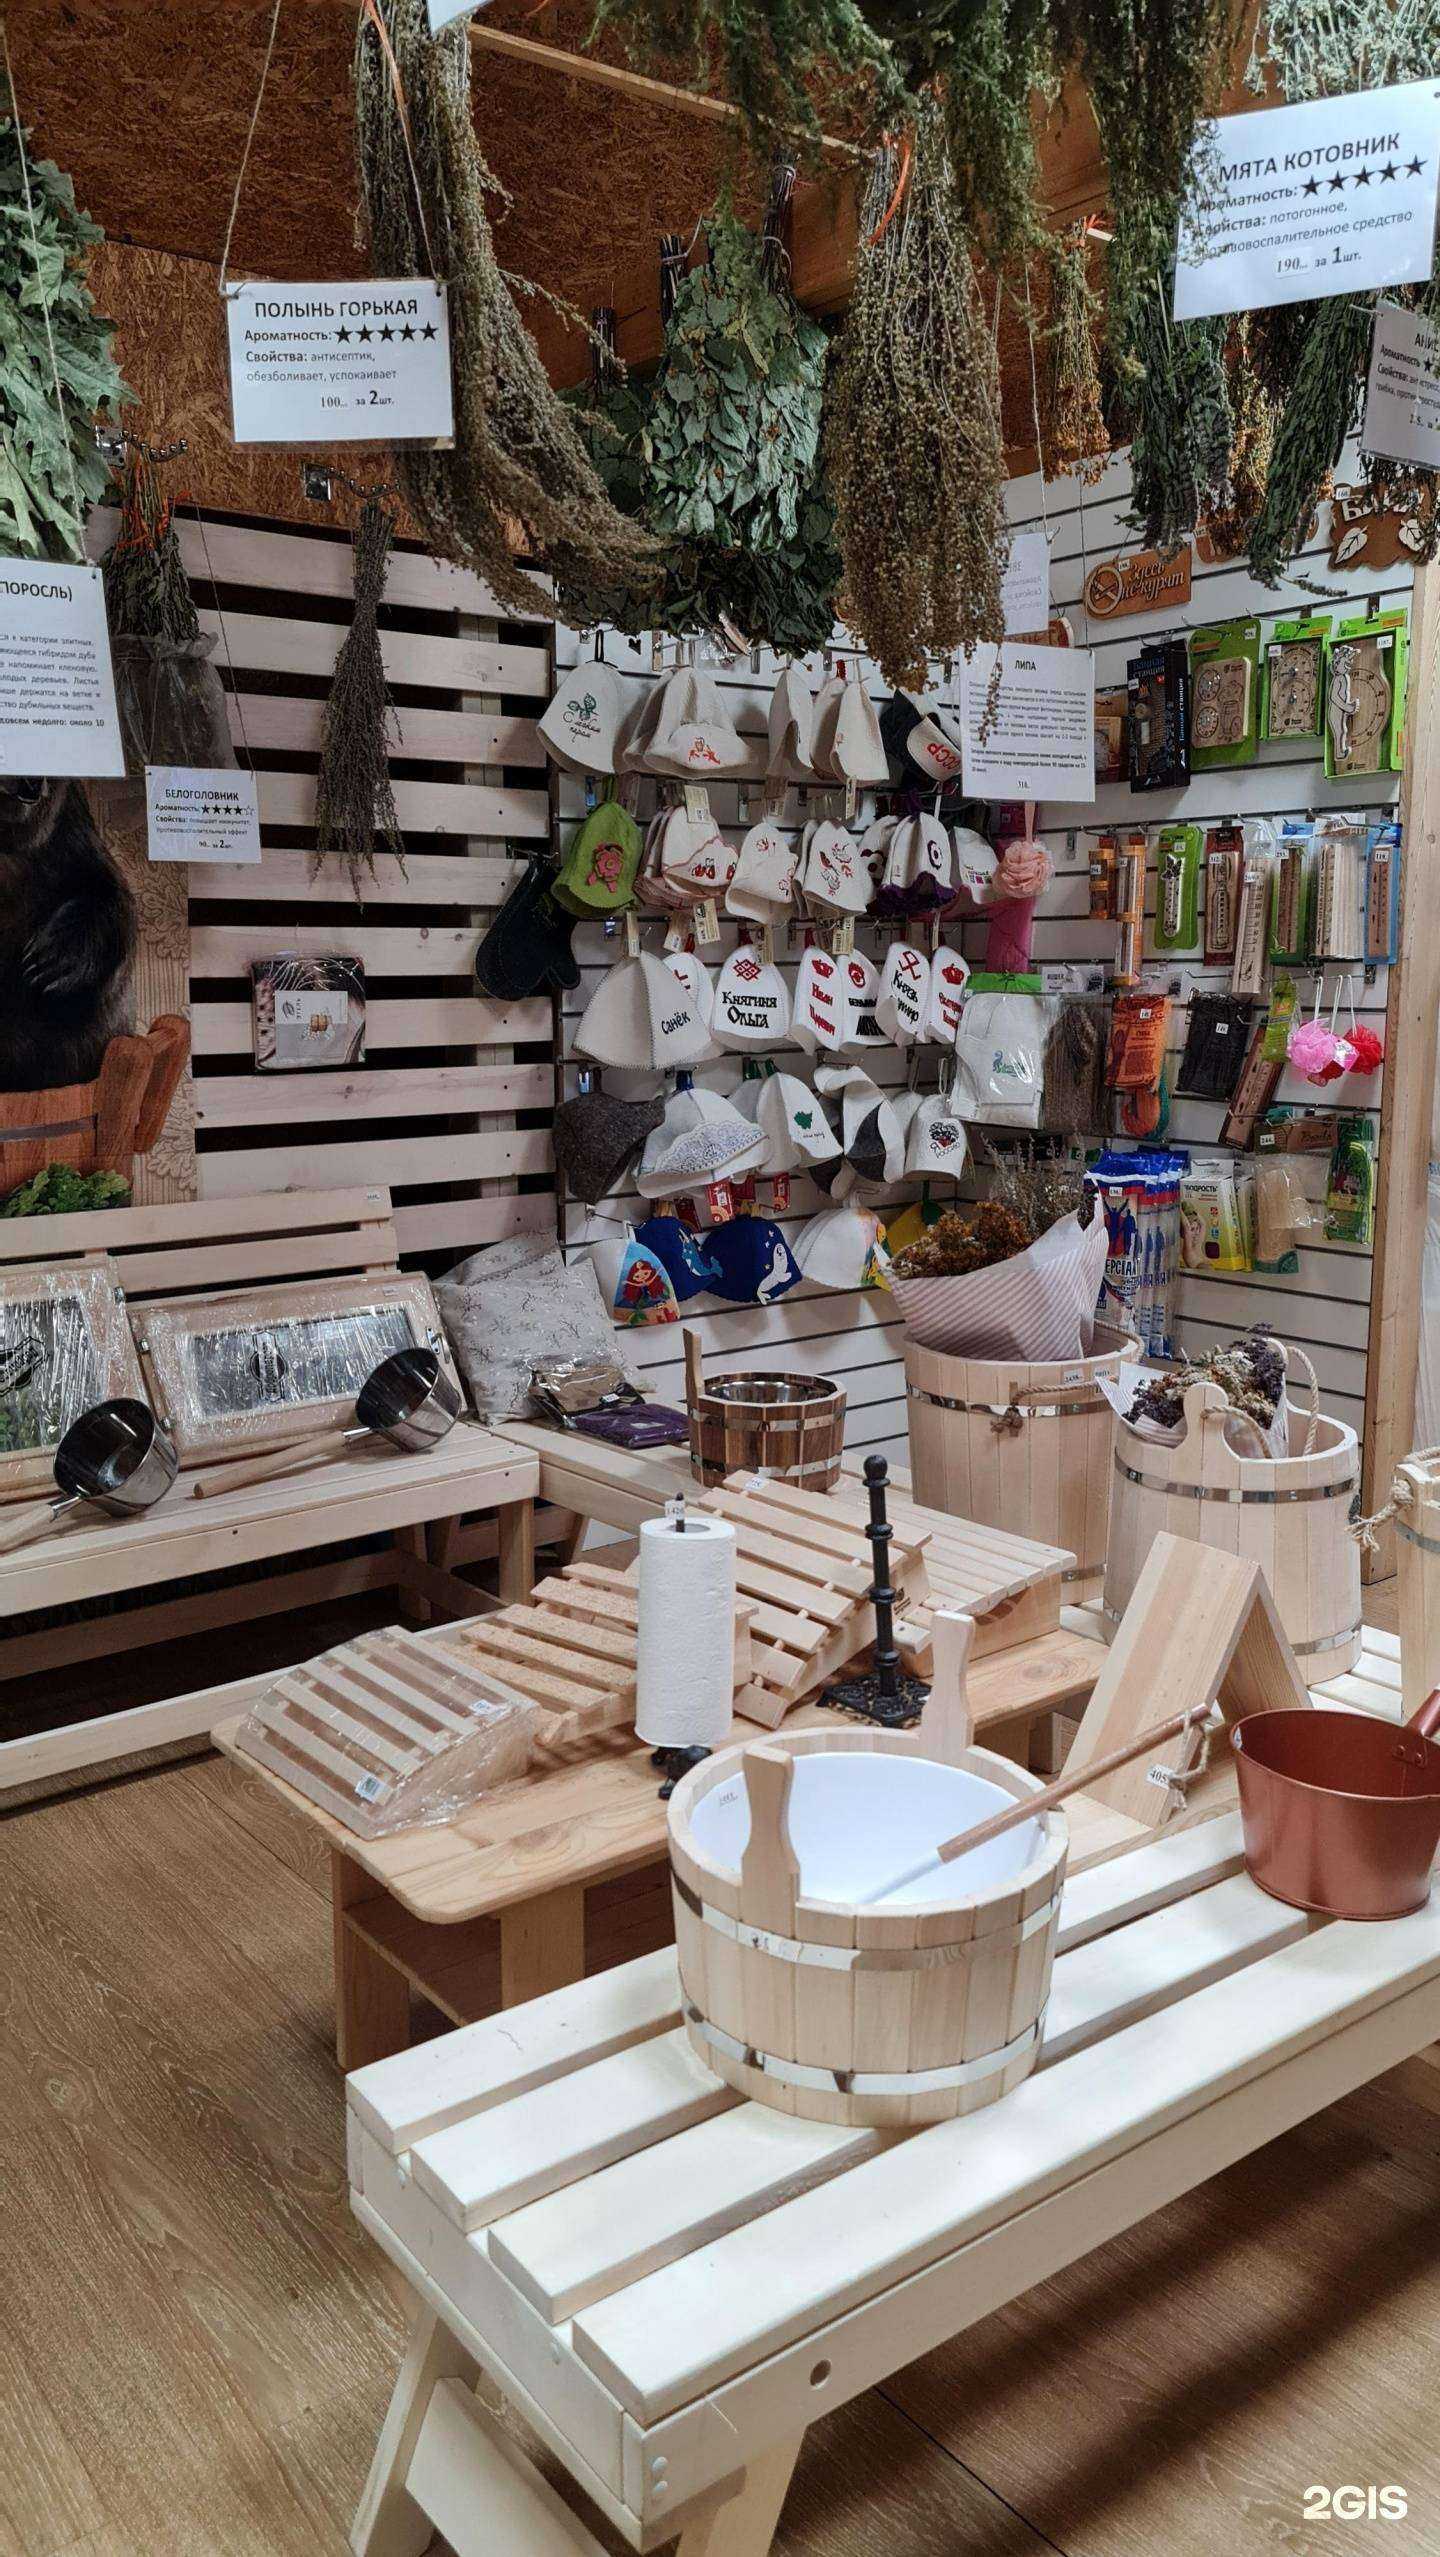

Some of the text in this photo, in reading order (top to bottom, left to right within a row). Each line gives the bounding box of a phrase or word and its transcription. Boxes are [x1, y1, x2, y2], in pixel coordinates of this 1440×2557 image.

[1219, 132, 1400, 183] МЯТА КОТОВНИК
[1269, 200, 1348, 225] потогонное,
[1352, 211, 1412, 232] средство
[255, 300, 418, 318] ПОЛЫНЬ ГОРЬКАЯ
[245, 330, 332, 344] Ароматность:
[246, 351, 376, 363] Свойства: антисептик,
[247, 369, 397, 383] обезболивает, успокаивает
[1014, 660, 1037, 671] ЛИПА
[165, 788, 240, 801] БЕЛОГОЛОВНИК
[661, 1011, 691, 1035] Санёк
